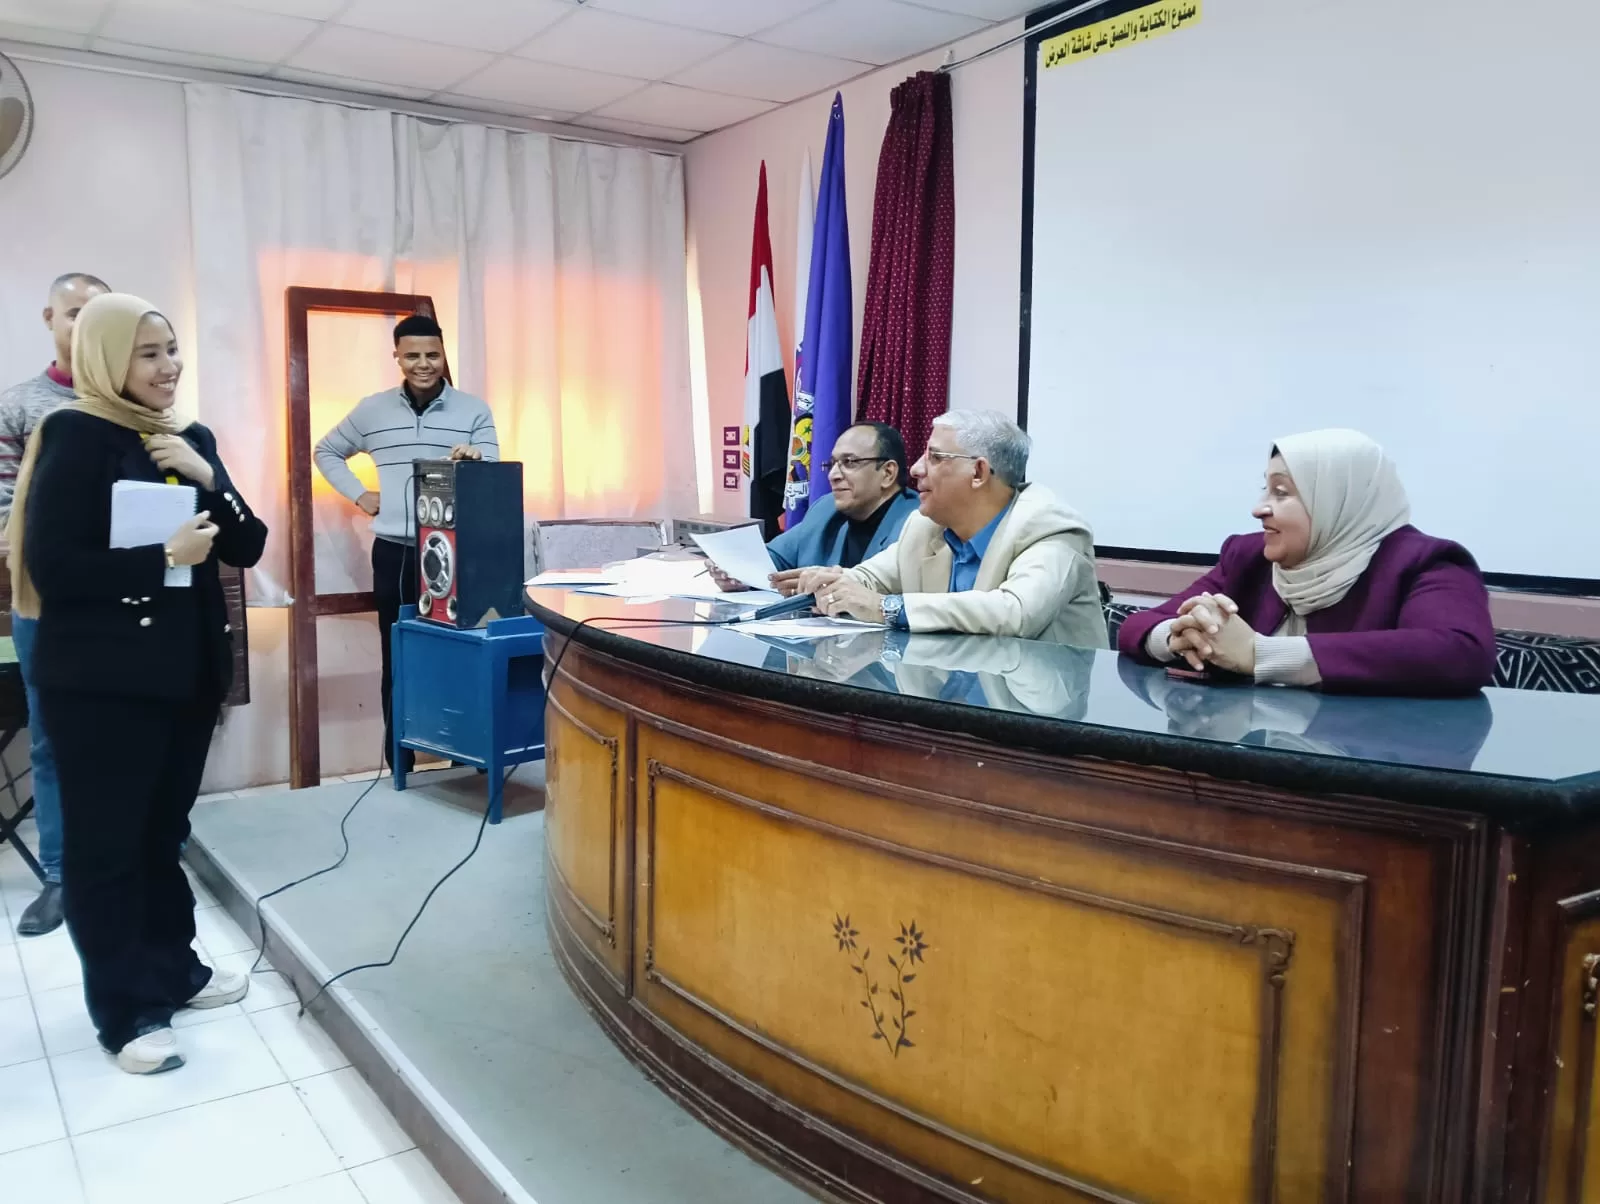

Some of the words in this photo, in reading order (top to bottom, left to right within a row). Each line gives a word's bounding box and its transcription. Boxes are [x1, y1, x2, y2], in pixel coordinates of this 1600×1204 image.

[1139, 8, 1170, 38] الكتابة
[1171, 2, 1196, 29] ممنوع
[1045, 42, 1070, 68] العرض
[1071, 31, 1091, 54] شاشة
